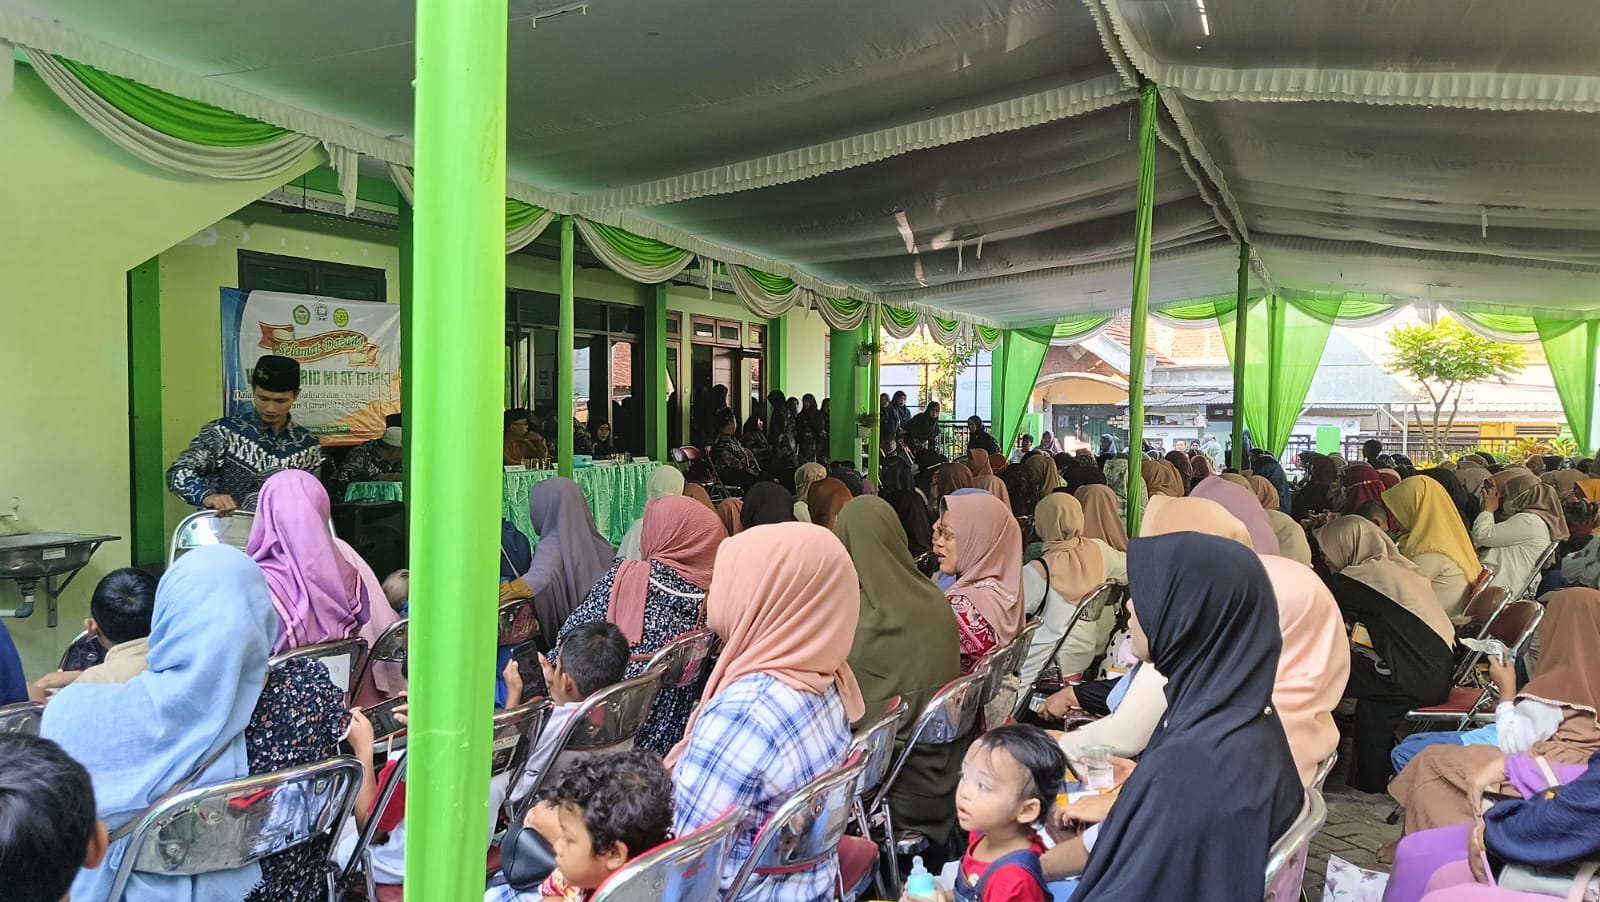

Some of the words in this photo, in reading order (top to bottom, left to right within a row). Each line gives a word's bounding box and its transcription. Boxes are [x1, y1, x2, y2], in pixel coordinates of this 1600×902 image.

[278, 343, 321, 357] Selamat
[322, 335, 364, 352] Datang
[300, 369, 320, 385] RID
